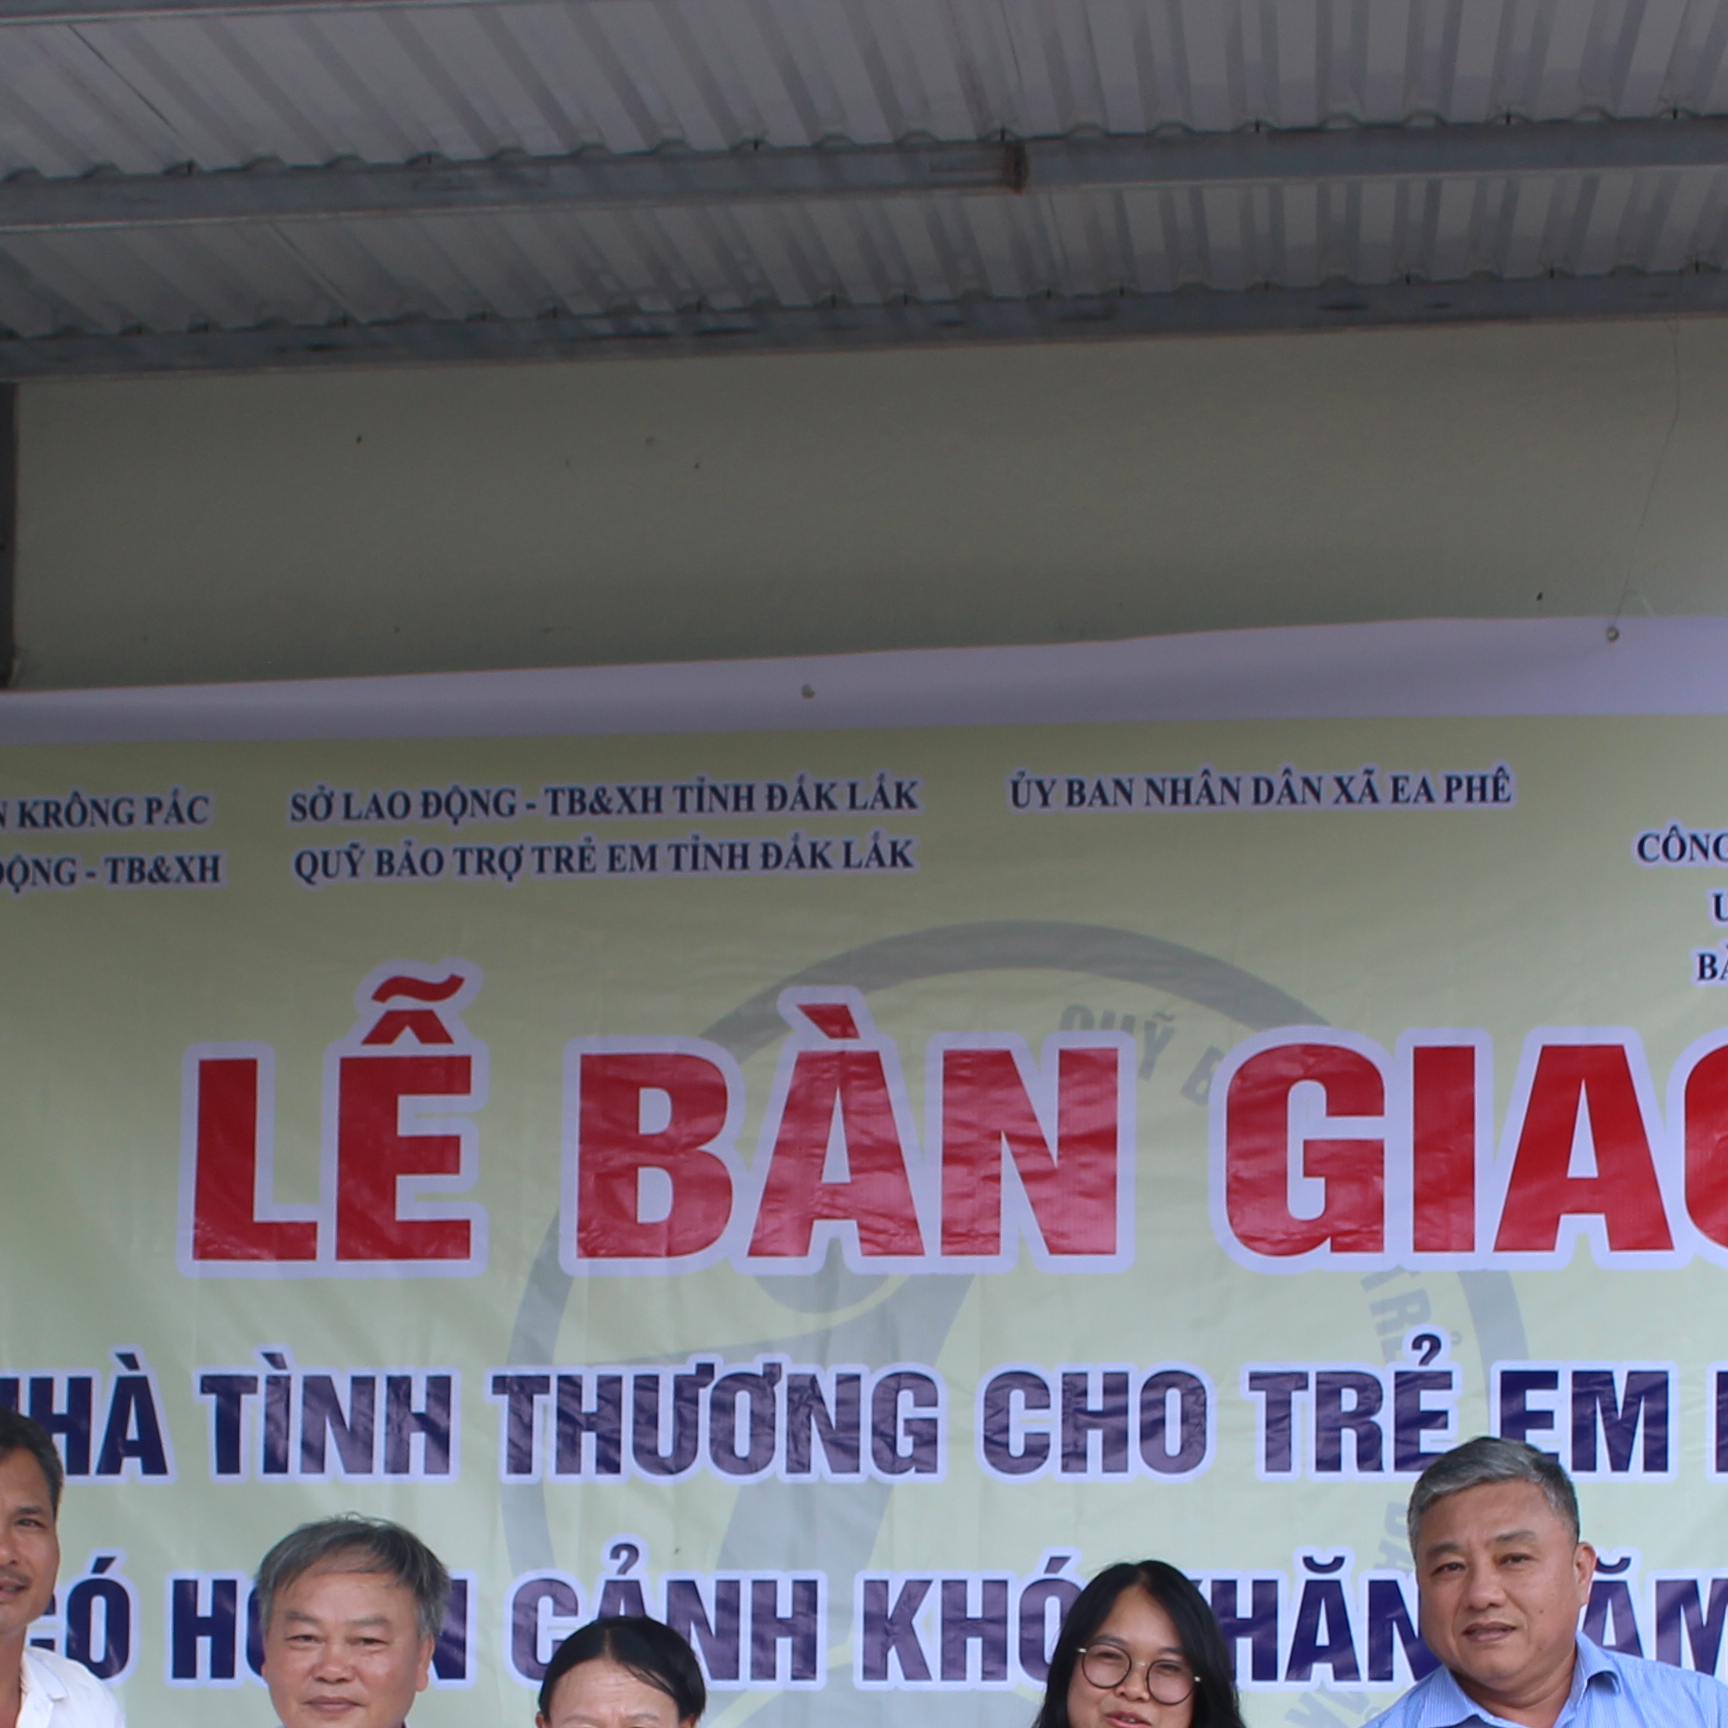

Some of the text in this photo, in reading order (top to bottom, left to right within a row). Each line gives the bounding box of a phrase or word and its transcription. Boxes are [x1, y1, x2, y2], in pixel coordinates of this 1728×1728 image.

[18, 791, 134, 827] KRÔNG
[291, 772, 919, 826] SỞ LAO ĐỘNG TB&XH TỈNH ĐẮK LẮK
[1010, 766, 1512, 809] ỦY BAN NHÂN DÂN XÃ EA PHÊ
[105, 855, 221, 885] TB&XH
[294, 831, 914, 885] QUỸ BẢO TRỢ TRẺ EM TỈNH ĐẮK LẮK
[194, 968, 476, 1262] LỄ
[573, 1001, 1121, 1261] BÀN
[199, 1353, 452, 1475] TÌNH
[492, 1361, 939, 1476] THƯƠNG
[983, 1369, 1210, 1475] CHO
[1249, 1332, 1453, 1473] TRẺ
[1499, 1369, 1670, 1473] EM
